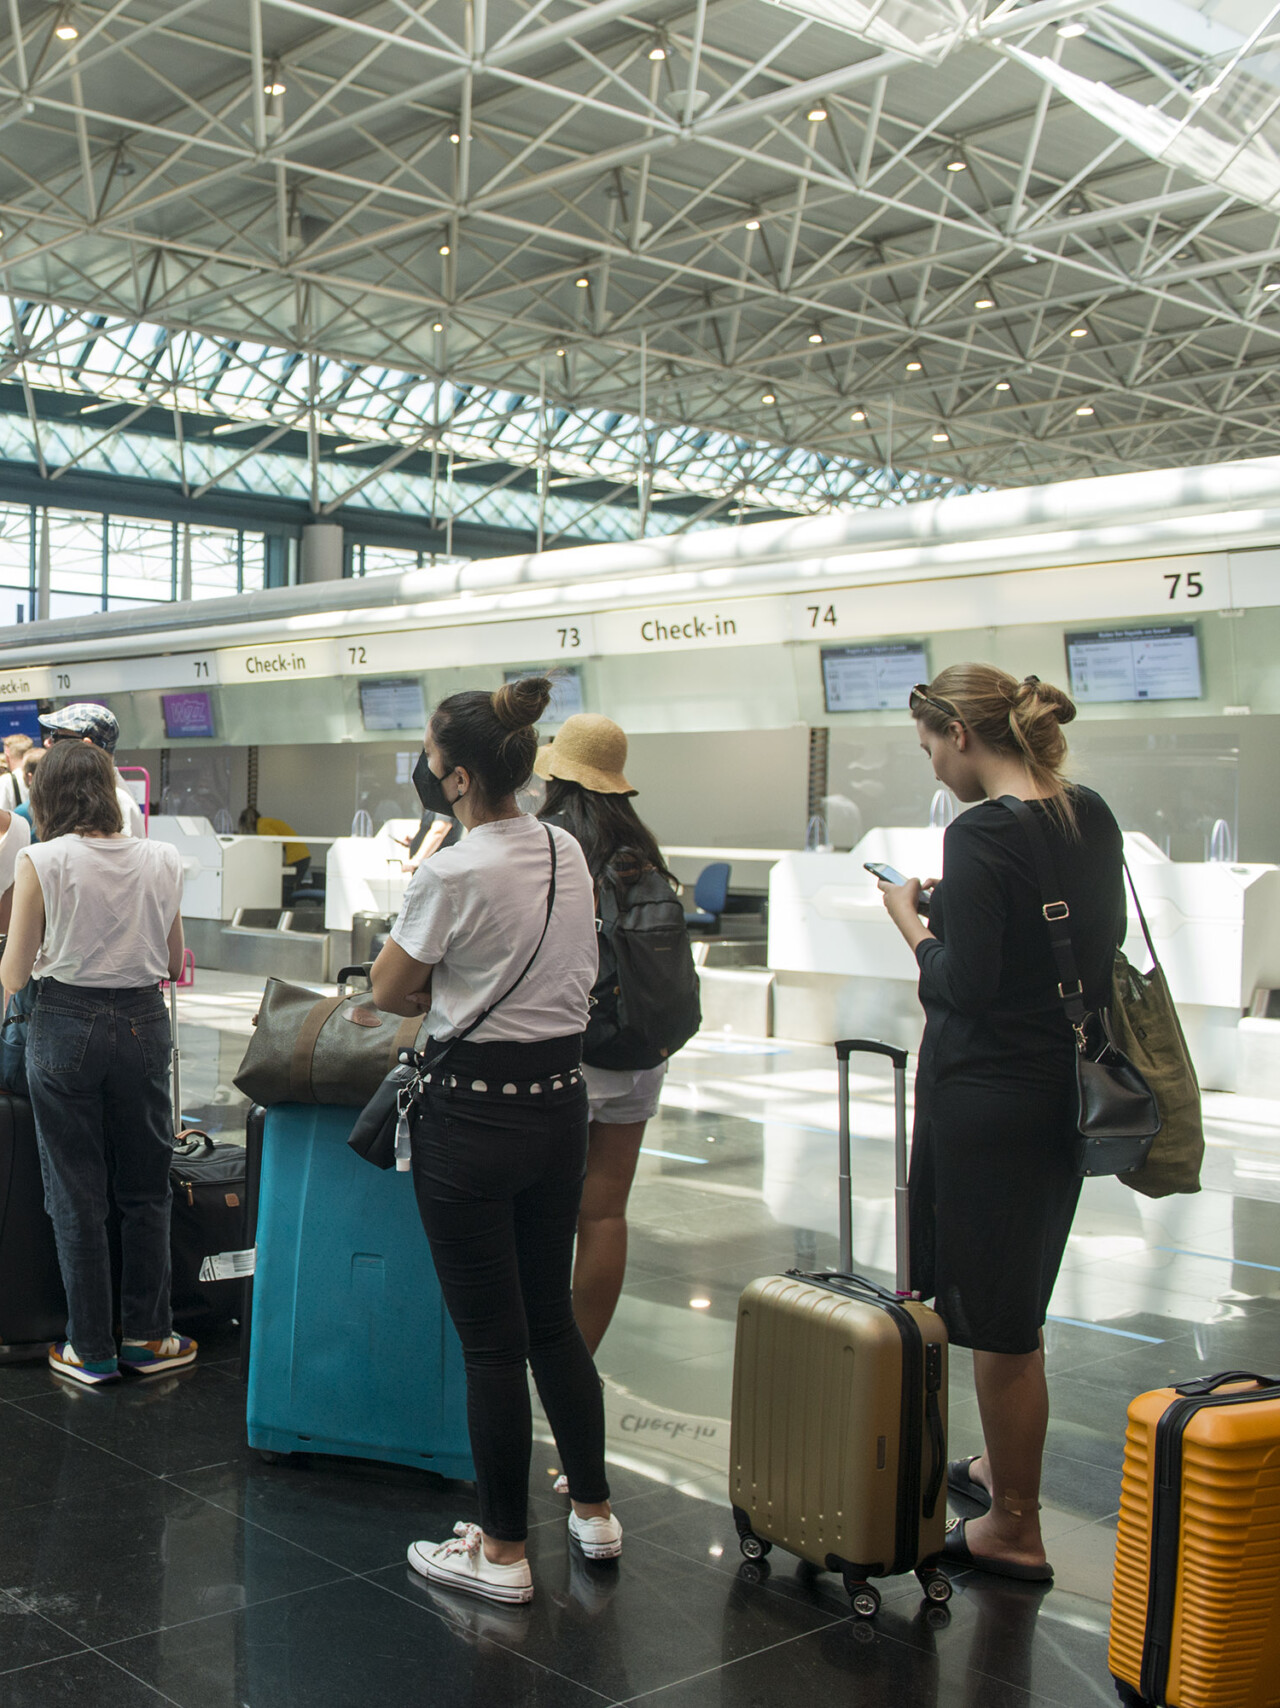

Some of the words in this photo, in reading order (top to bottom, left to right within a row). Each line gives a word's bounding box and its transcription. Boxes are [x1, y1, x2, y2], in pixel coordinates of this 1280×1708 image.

[1163, 572, 1203, 599] 75
[557, 628, 580, 648] 73
[641, 615, 737, 642] Check-in
[807, 605, 837, 628] 74
[194, 661, 209, 678] 71
[246, 653, 306, 674] Check-in
[348, 647, 367, 665] 72
[57, 674, 71, 689] 70
